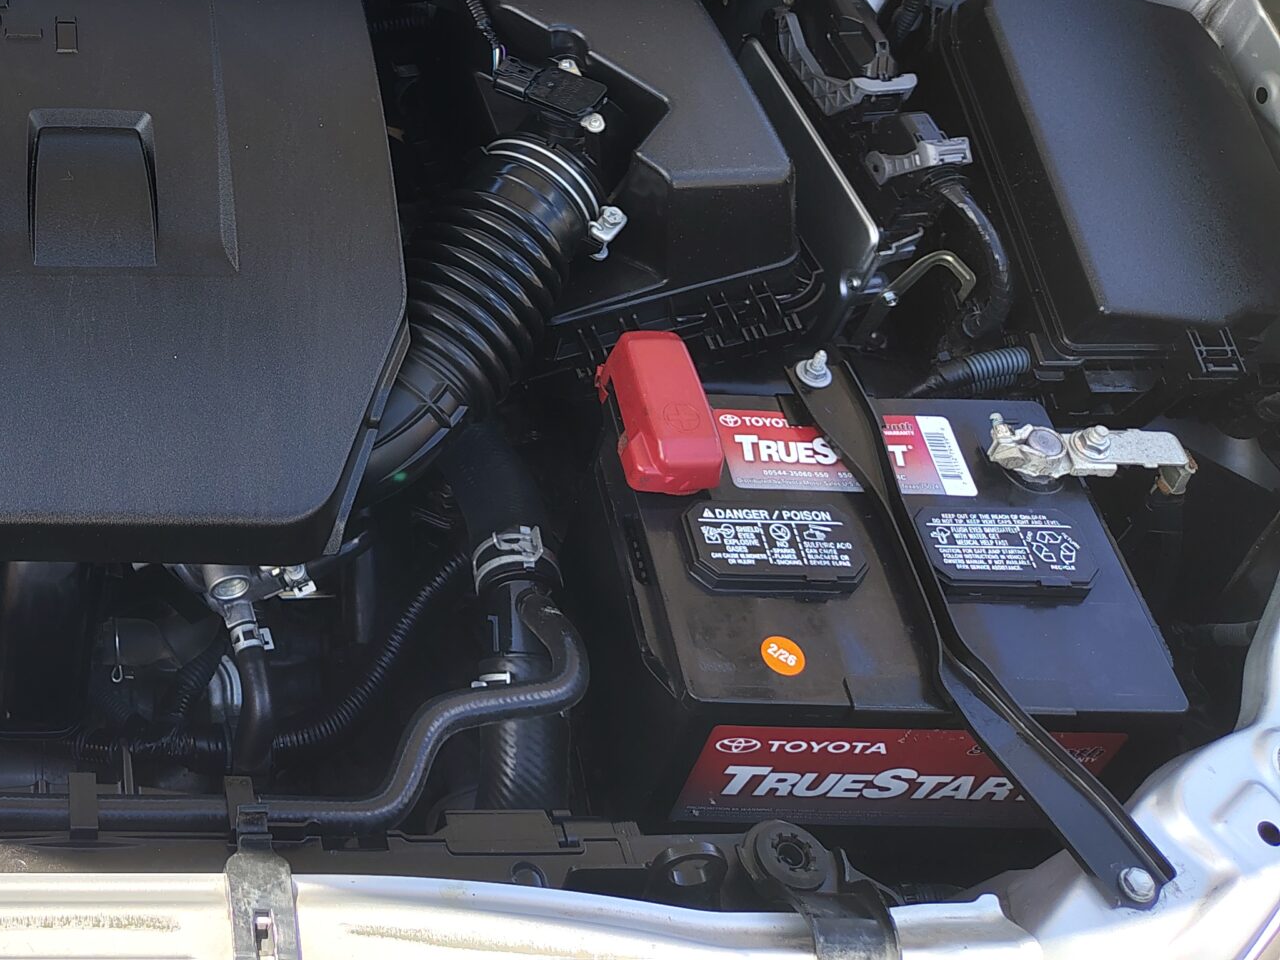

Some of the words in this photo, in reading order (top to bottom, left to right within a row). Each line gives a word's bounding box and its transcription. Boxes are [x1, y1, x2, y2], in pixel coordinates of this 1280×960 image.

[742, 416, 803, 429] TOYOT
[715, 508, 770, 520] DANGER
[772, 510, 779, 520] /
[782, 510, 832, 521] POISON
[724, 538, 760, 546] EXPLOSIVE
[776, 540, 789, 548] NO
[836, 542, 852, 550] ACID
[767, 643, 798, 667] 2/26
[768, 740, 888, 755] TOYOTA
[720, 765, 1026, 802] TRUESTAR
